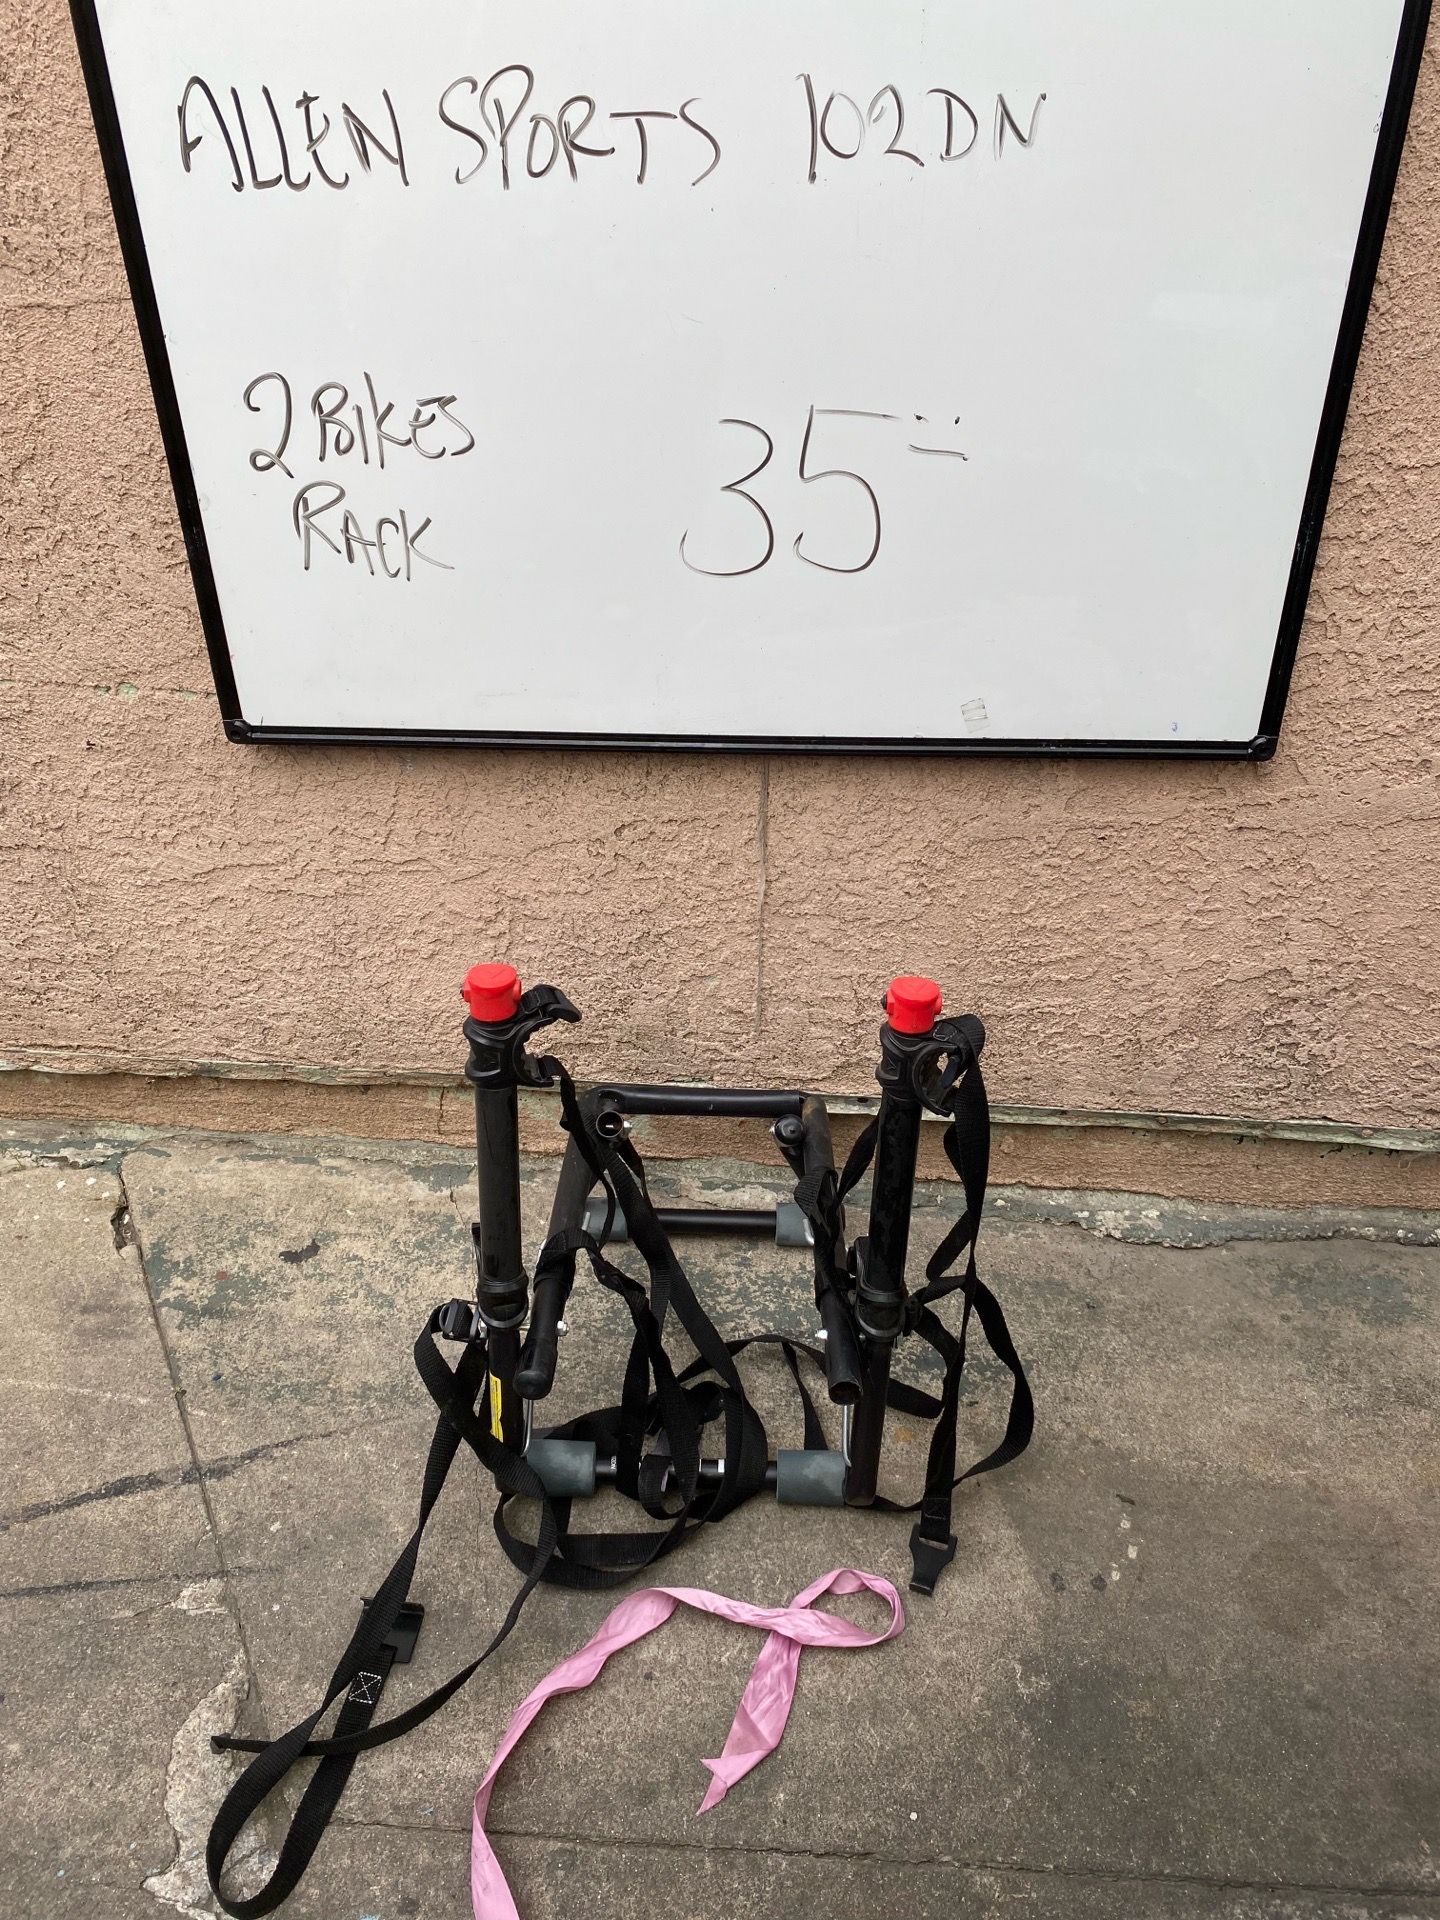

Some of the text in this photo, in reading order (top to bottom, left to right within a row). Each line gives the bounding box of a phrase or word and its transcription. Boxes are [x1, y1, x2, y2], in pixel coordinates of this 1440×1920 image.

[177, 75, 410, 193] ALLEN
[438, 64, 721, 191] SPORTS
[243, 371, 295, 480] 2
[292, 479, 455, 582] RACK
